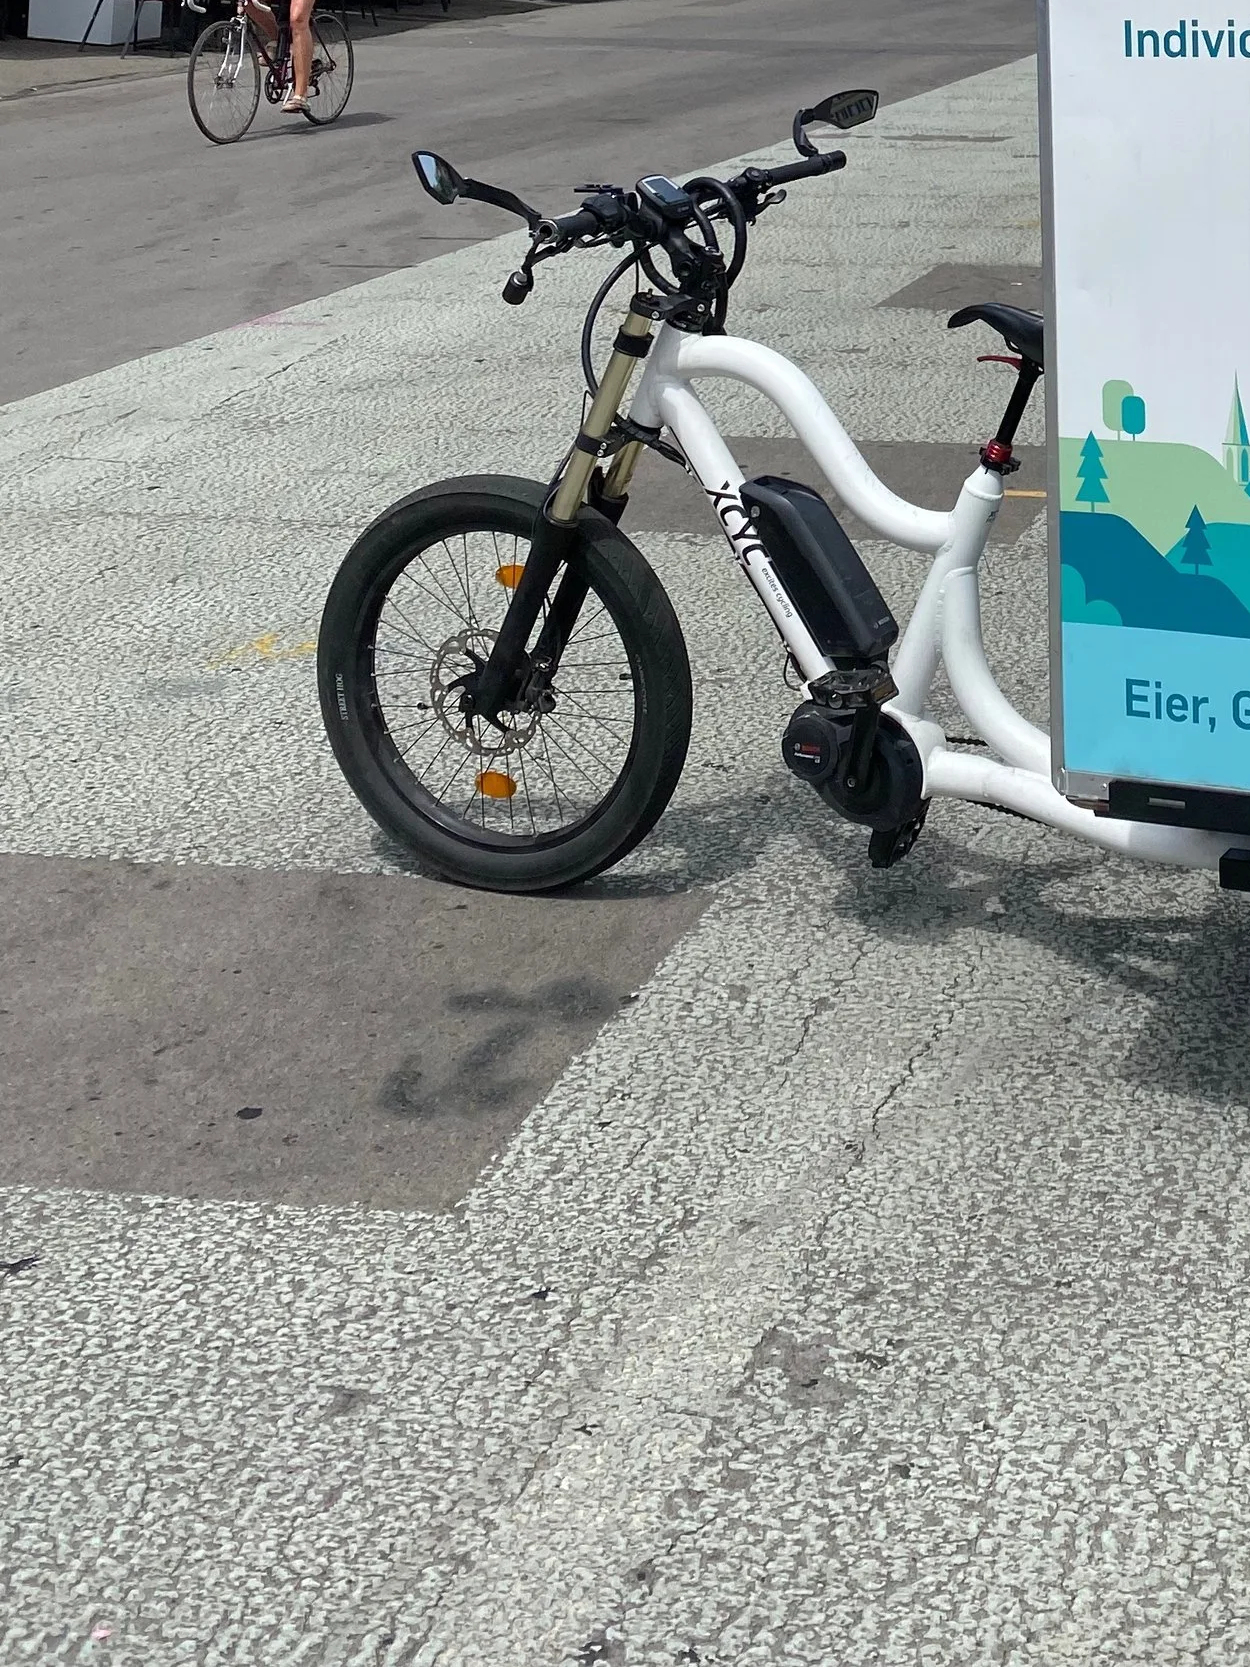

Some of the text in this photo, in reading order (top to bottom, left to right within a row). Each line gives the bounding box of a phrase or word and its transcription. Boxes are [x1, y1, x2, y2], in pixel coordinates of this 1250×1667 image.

[705, 480, 770, 565] XCYC
[761, 567, 793, 618] excites cycling
[337, 693, 349, 720] STREET
[1125, 677, 1216, 734] Eier,
